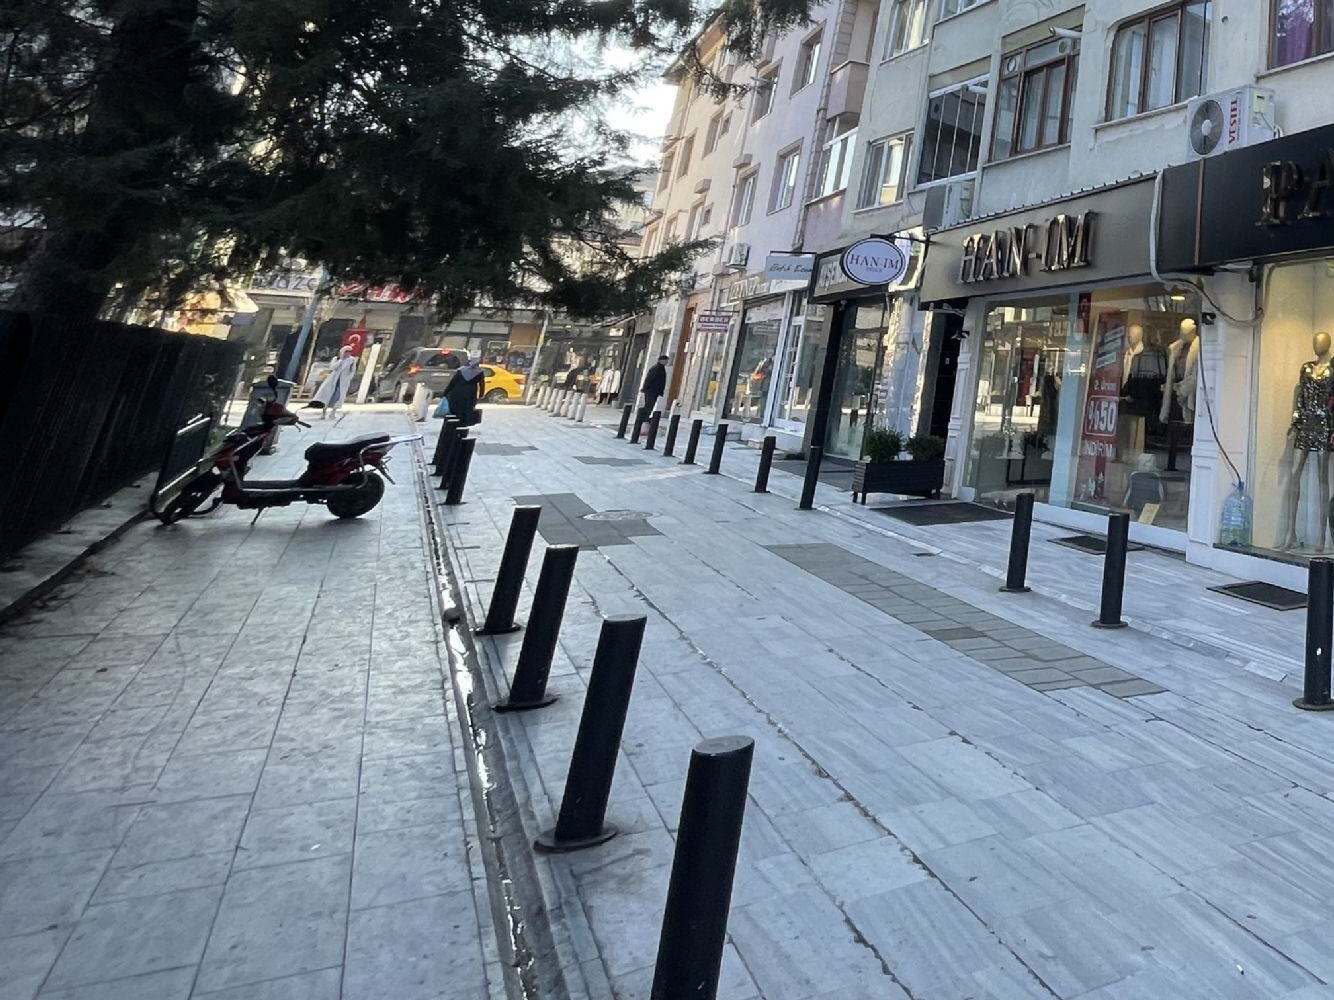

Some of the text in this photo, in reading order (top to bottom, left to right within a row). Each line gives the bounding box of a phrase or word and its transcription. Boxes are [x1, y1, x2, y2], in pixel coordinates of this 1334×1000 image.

[1228, 96, 1239, 144] VESTEL
[849, 253, 899, 270] HAN-IM
[960, 209, 1100, 283] HAN-IM
[1088, 400, 1117, 432] %50
